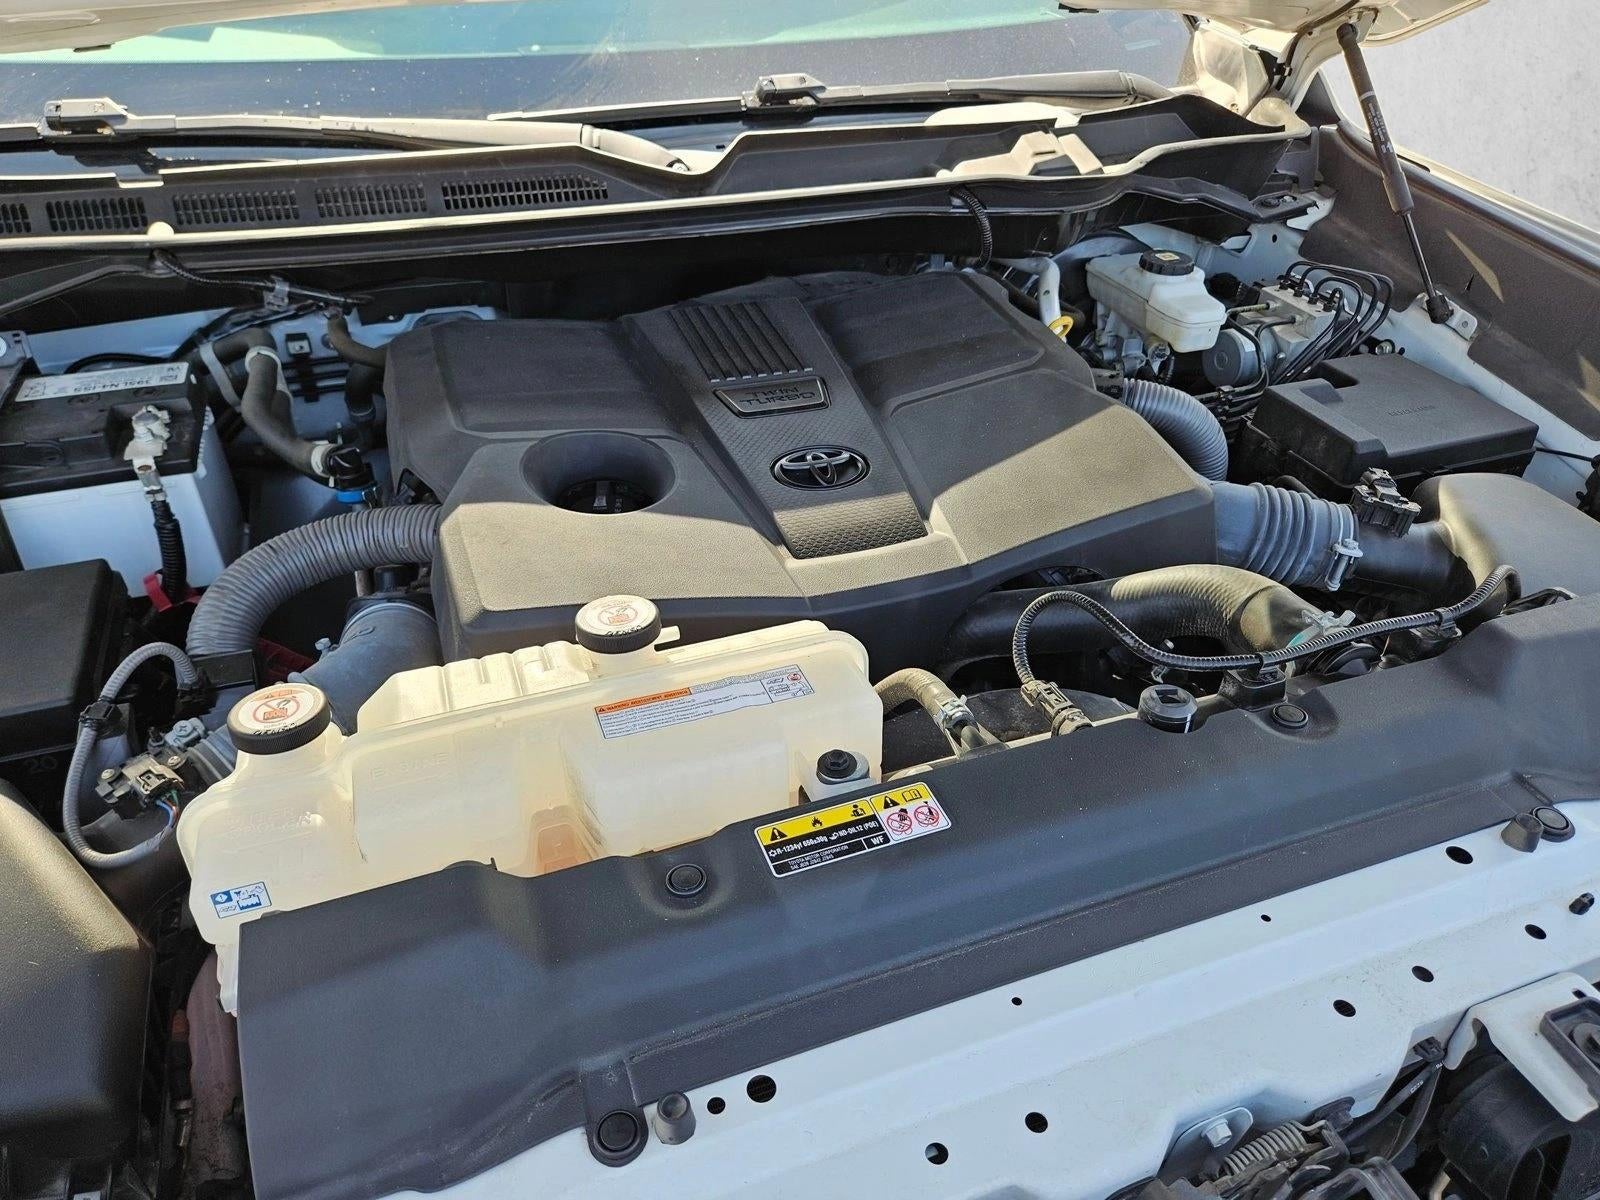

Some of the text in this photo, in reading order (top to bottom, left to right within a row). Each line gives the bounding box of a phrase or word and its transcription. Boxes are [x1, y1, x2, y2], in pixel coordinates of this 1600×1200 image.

[740, 391, 816, 405] TURBO
[745, 386, 800, 398] TWIN
[871, 836, 884, 845] WF
[788, 845, 849, 866] TOYOTA MOTOR CORPORATION
